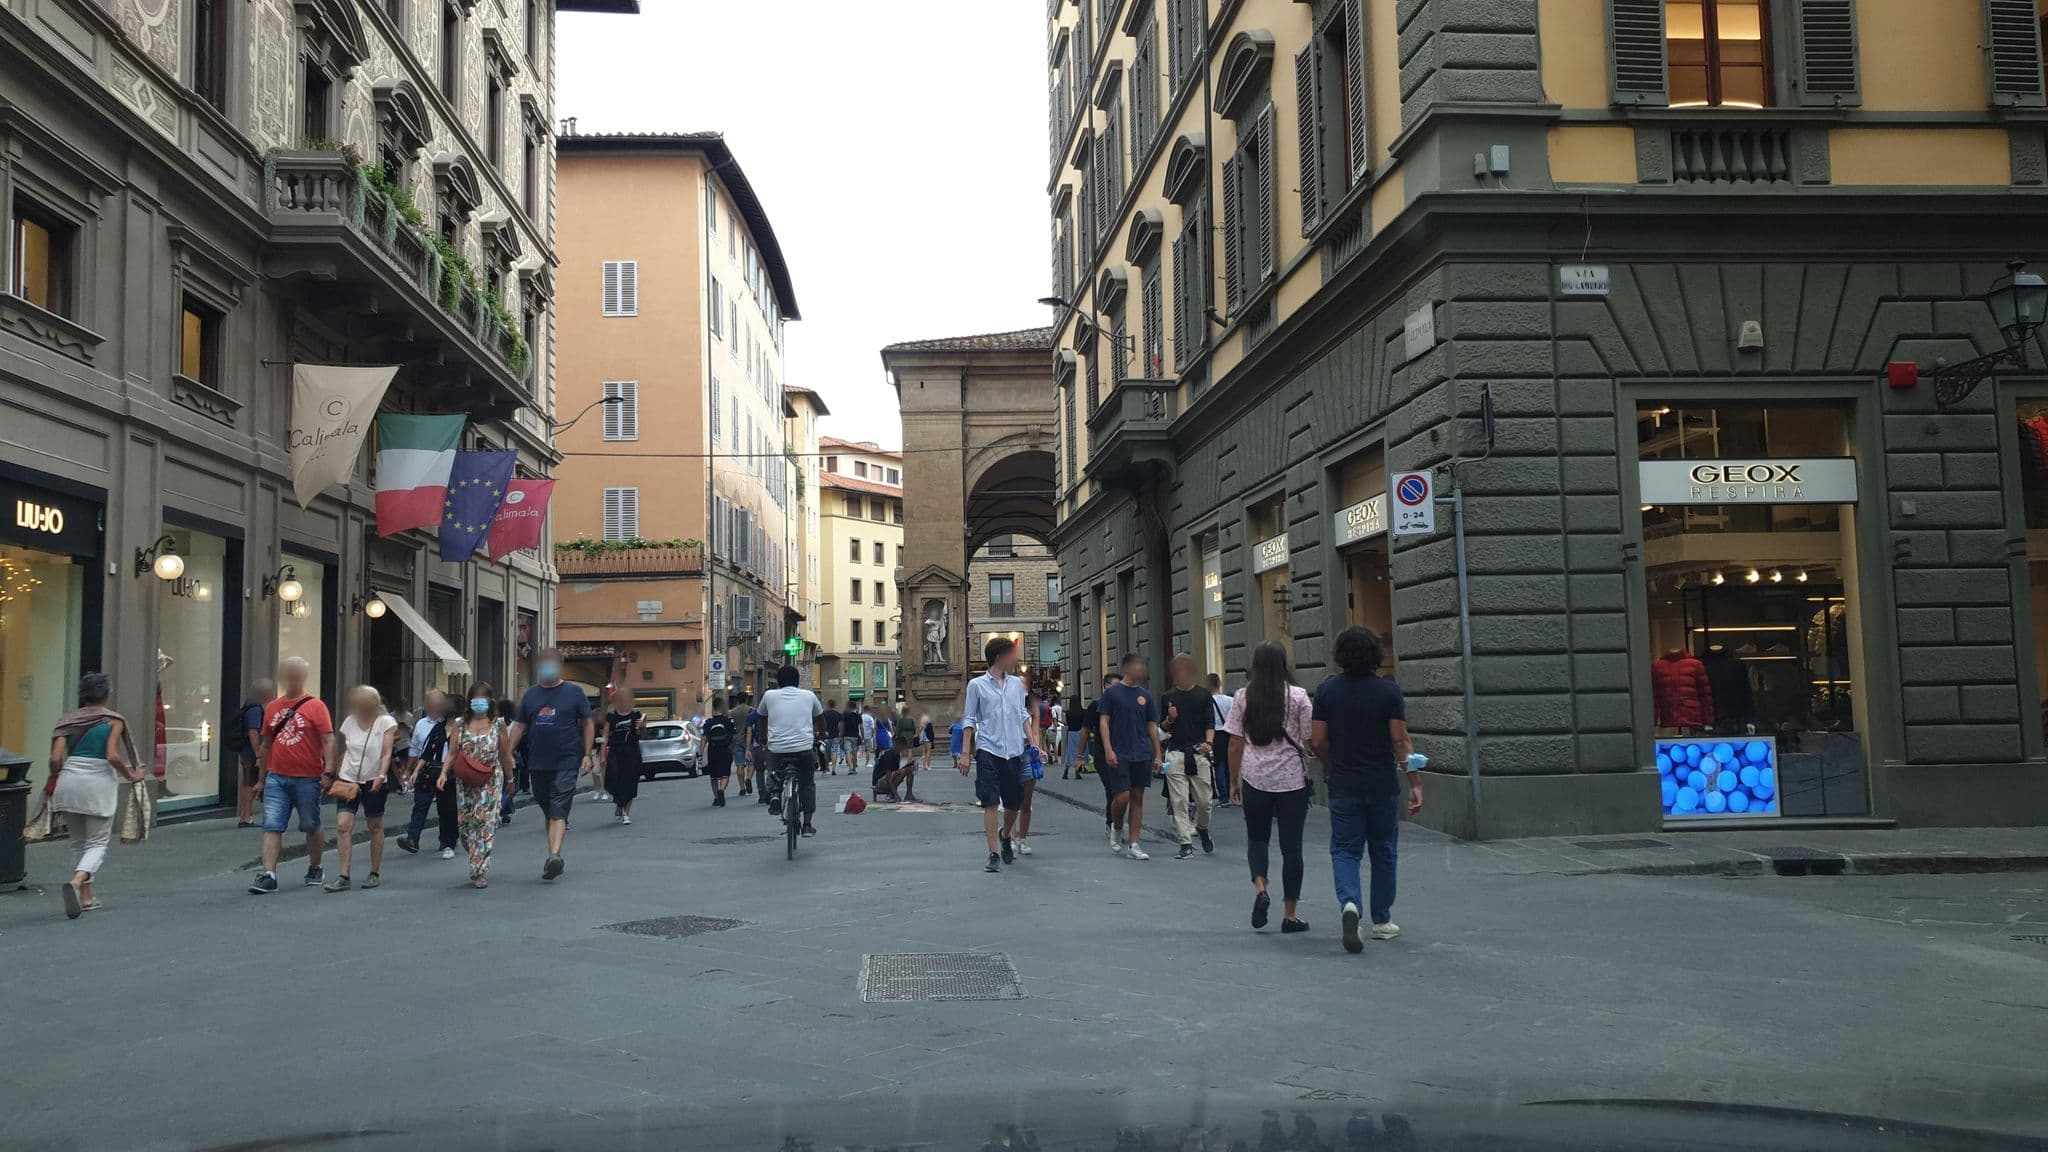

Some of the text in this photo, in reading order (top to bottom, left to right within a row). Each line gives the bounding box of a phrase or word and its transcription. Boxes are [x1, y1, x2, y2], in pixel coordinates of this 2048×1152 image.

[1690, 464, 1802, 484] GEOX
[1690, 486, 1804, 500] RESPIRA
[494, 506, 539, 521] alimala
[1346, 500, 1379, 526] GEOX
[1261, 537, 1285, 558] GEOX
